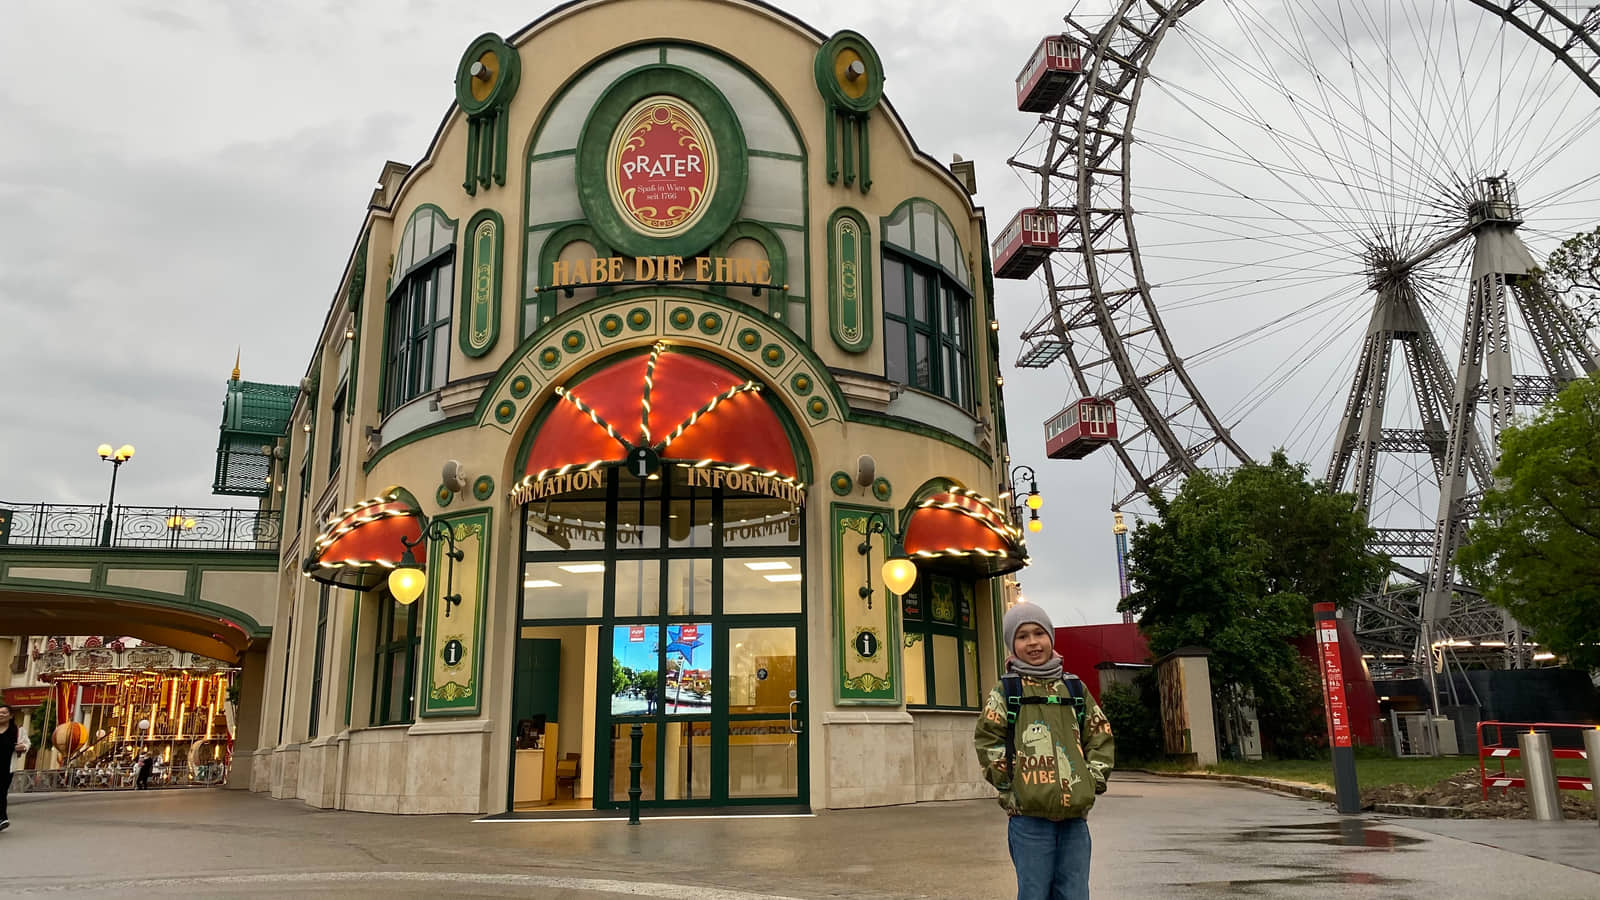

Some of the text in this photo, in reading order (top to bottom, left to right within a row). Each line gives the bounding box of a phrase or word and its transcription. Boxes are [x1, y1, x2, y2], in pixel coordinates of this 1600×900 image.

[622, 154, 702, 180] PRATER
[657, 184, 665, 192] in
[665, 184, 686, 192] Wien
[646, 192, 677, 200] seit 1766
[552, 255, 773, 287] HABE DIE EHRE
[1019, 755, 1056, 771] ROAR
[1022, 770, 1056, 785] VIBE
